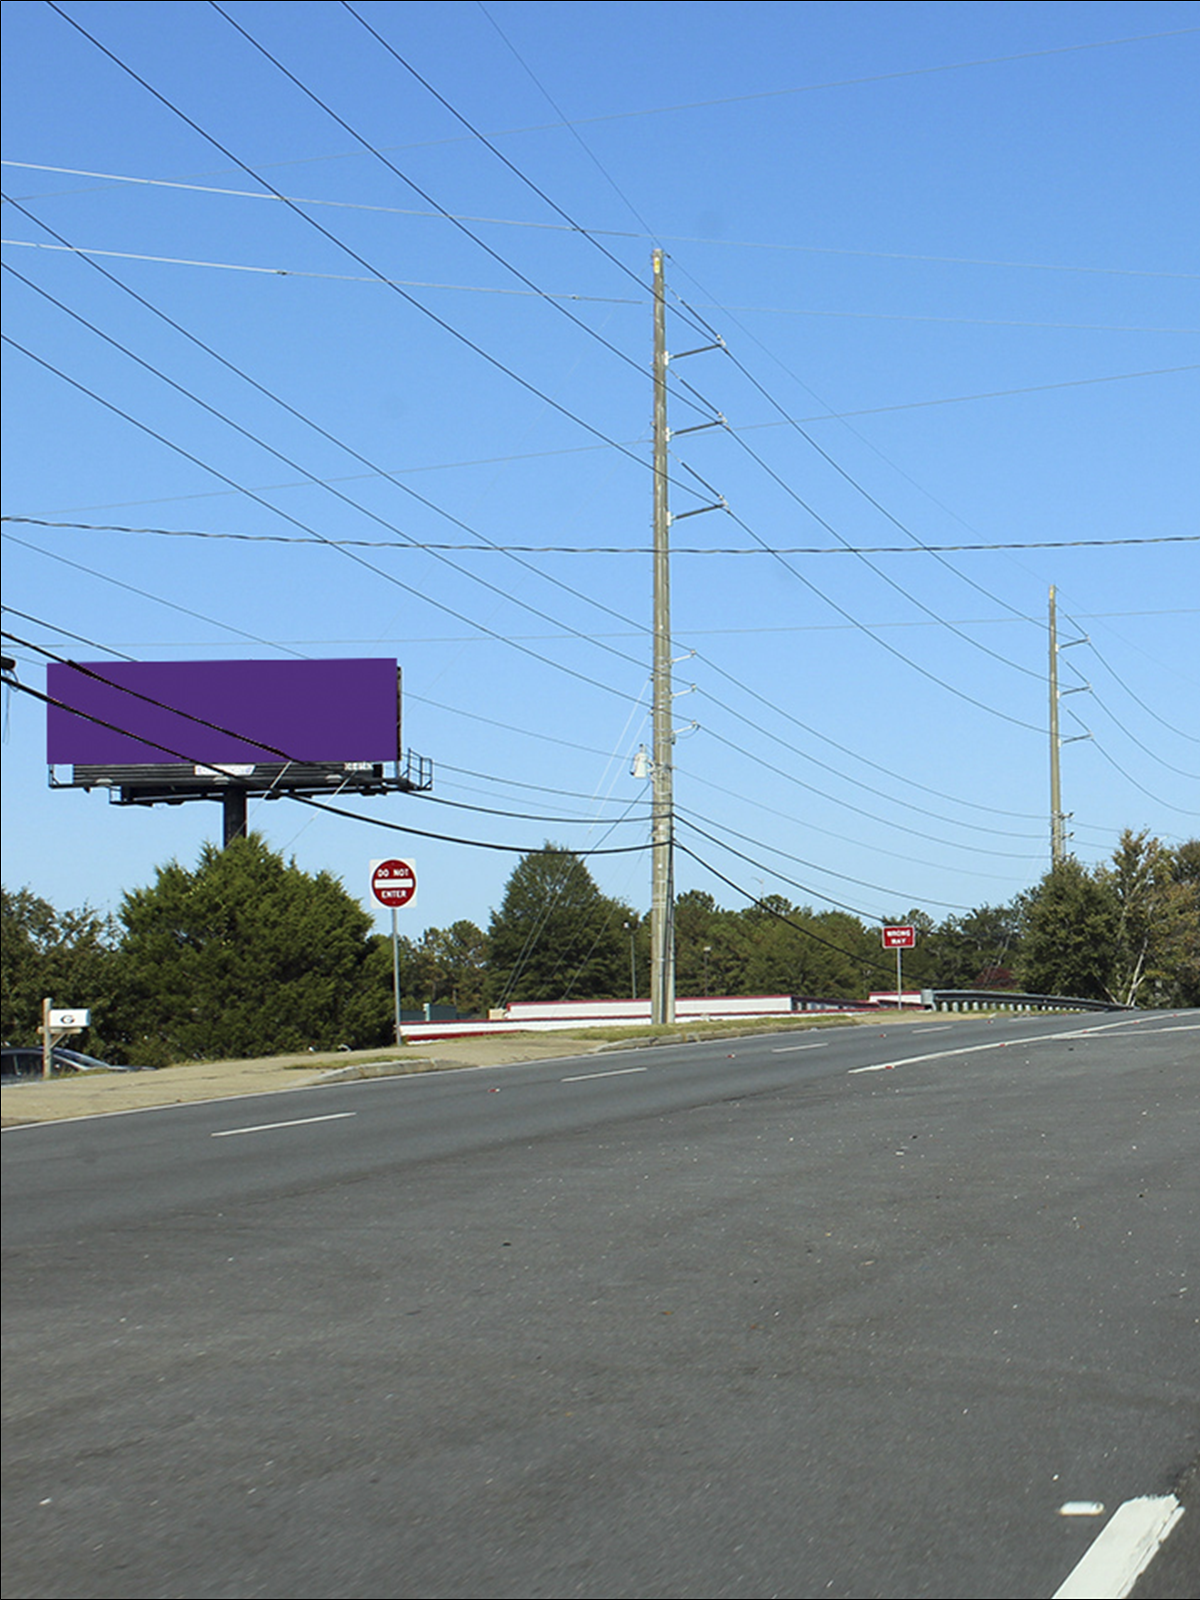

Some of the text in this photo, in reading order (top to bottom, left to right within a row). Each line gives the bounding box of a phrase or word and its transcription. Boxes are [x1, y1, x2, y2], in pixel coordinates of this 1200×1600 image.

[377, 868, 409, 878] DO NOT
[381, 890, 407, 899] ENTER
